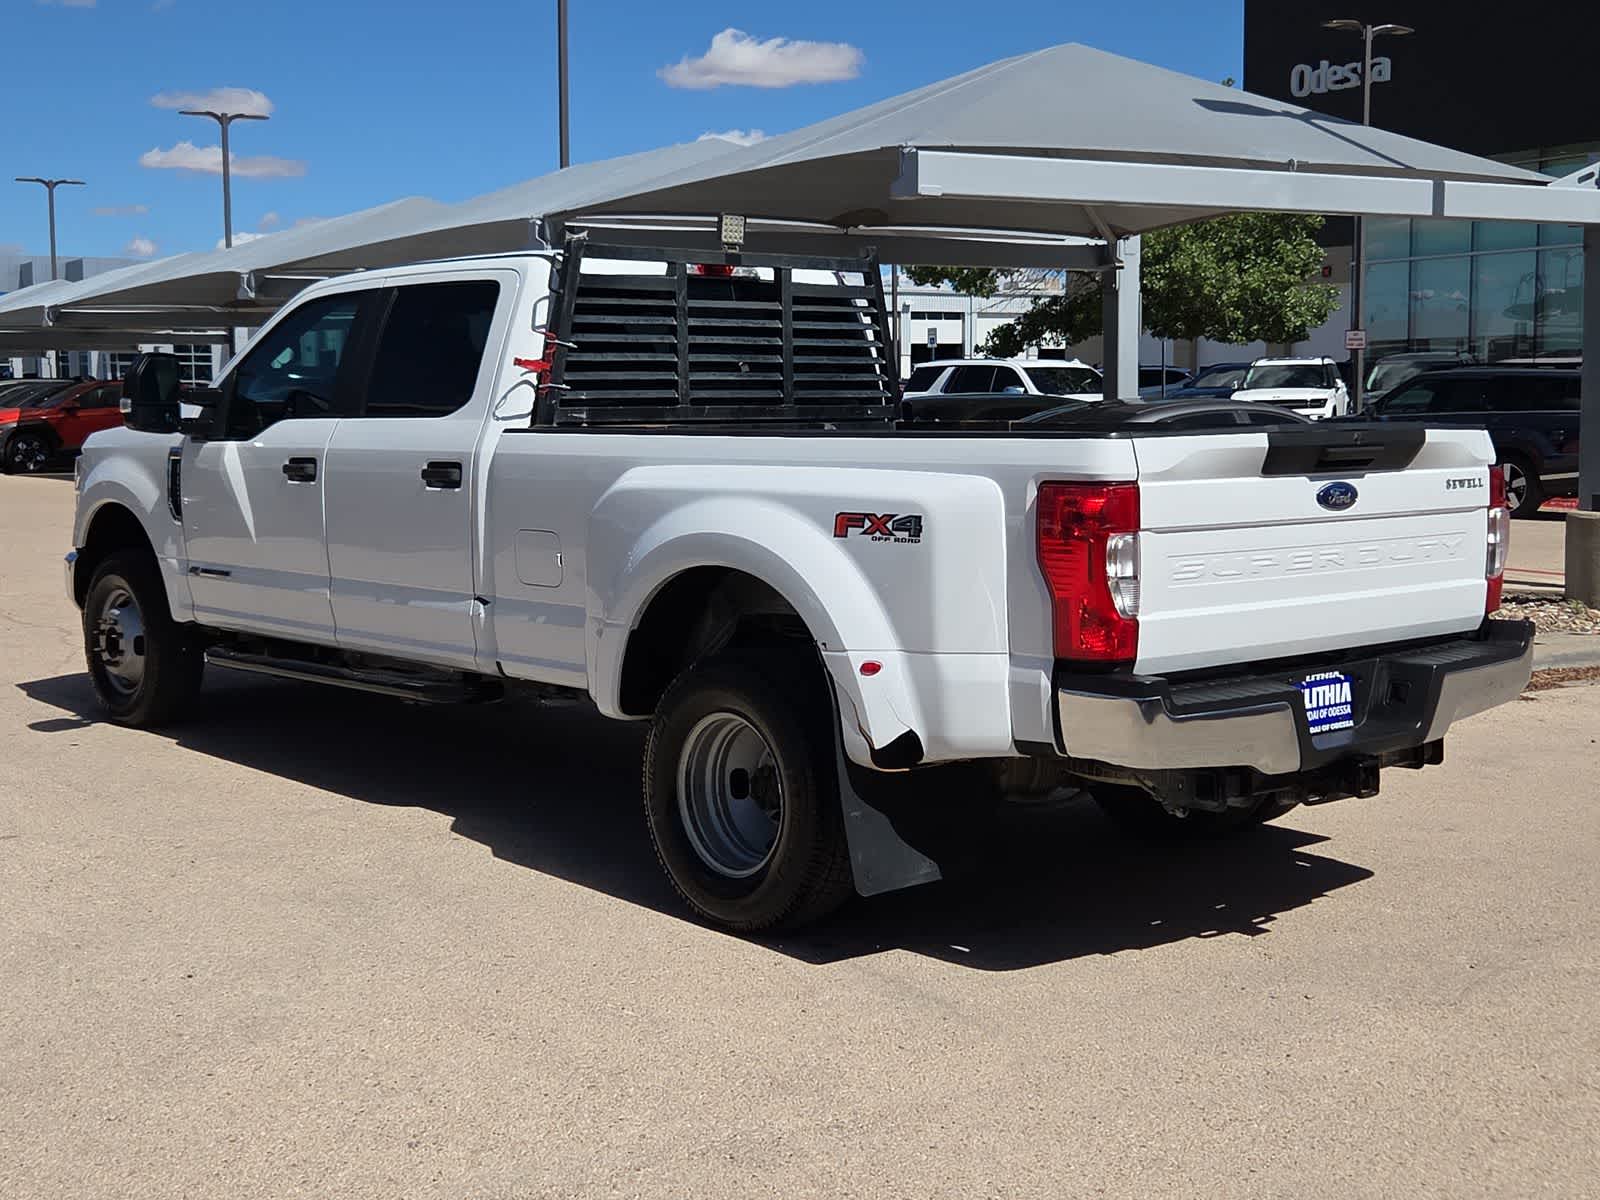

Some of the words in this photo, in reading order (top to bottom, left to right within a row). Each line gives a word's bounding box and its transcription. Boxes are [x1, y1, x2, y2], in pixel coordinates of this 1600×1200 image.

[1290, 56, 1392, 97] Odesa
[1446, 477, 1484, 490] SEWELL
[833, 512, 923, 538] FX4
[894, 536, 921, 544] ROAD
[1172, 549, 1345, 582] SUPER
[1359, 536, 1464, 565] DUTY
[1304, 682, 1352, 709] LITHIA
[1319, 708, 1328, 719] OF
[1328, 704, 1352, 717] ODESSA
